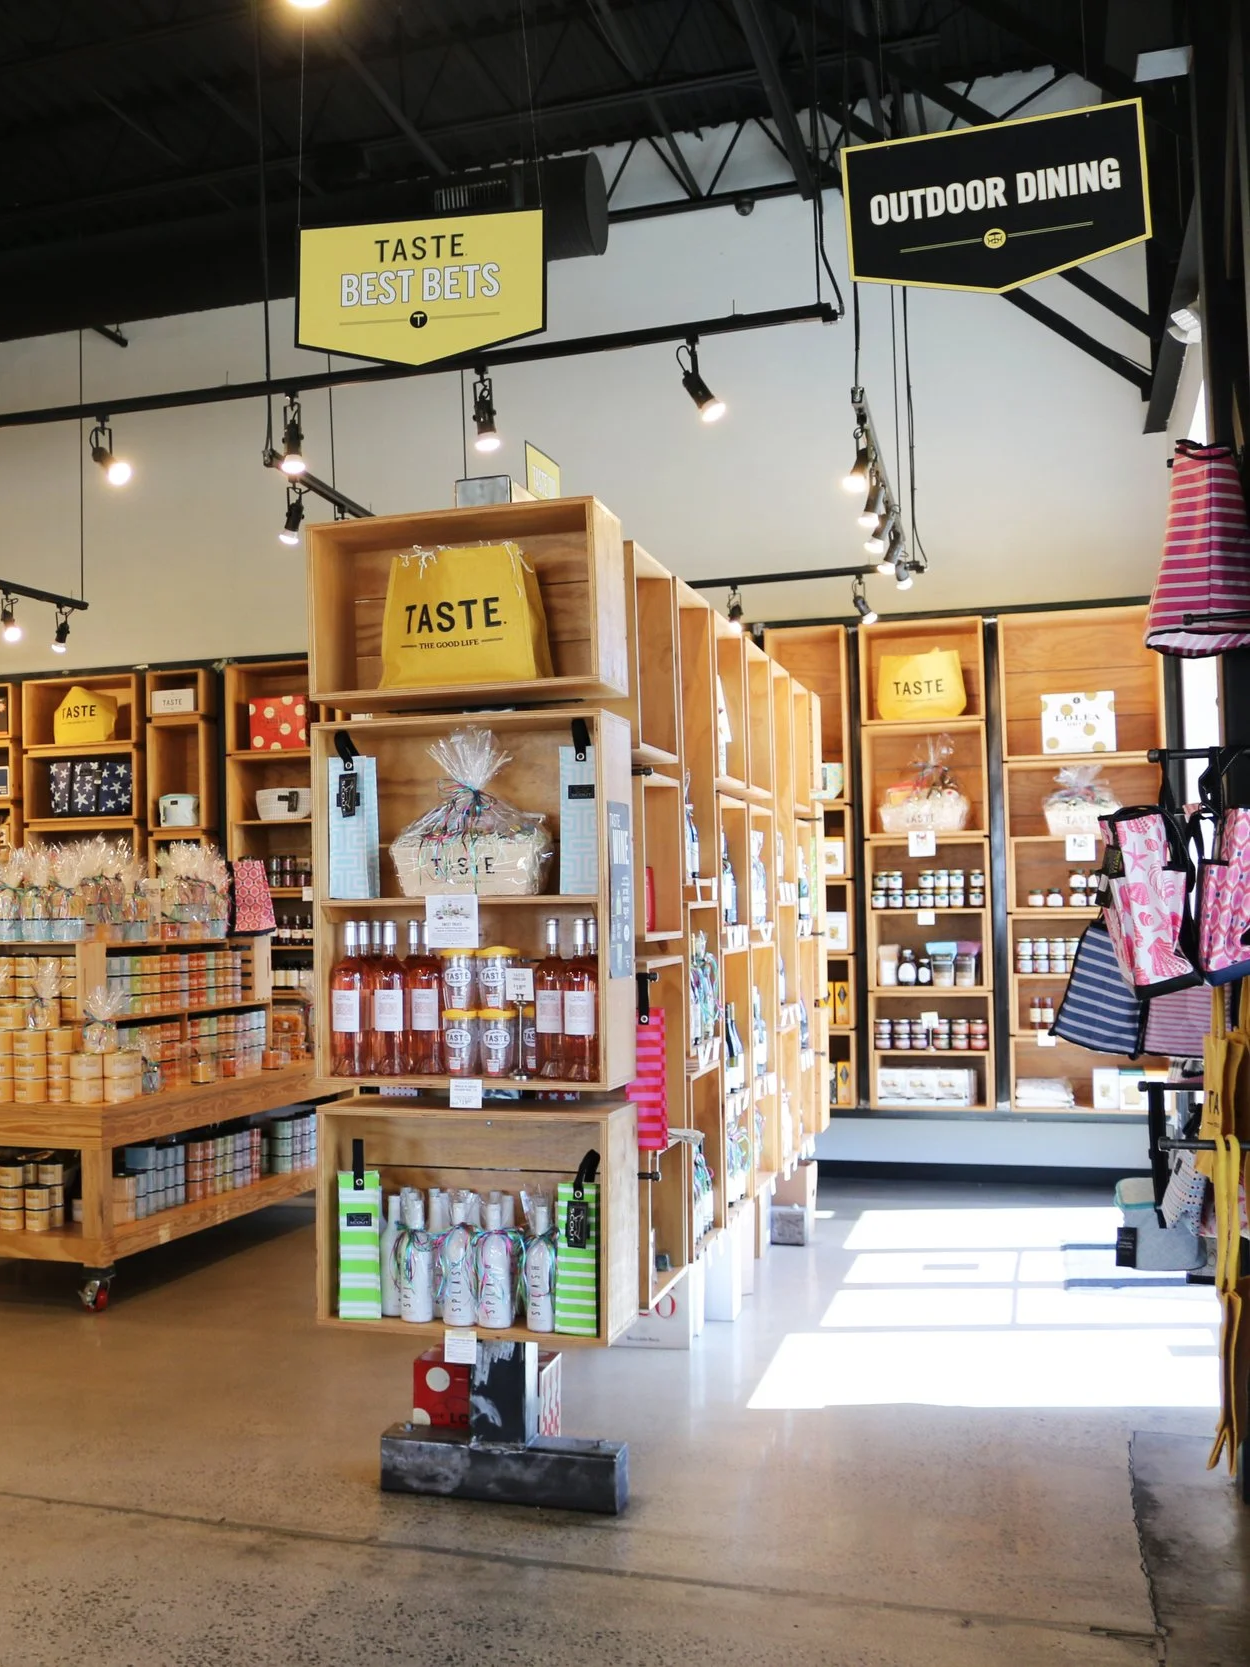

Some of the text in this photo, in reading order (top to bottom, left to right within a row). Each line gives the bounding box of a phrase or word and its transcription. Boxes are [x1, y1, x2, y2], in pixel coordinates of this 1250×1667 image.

[869, 157, 1122, 226] OUTDOOR DINING
[374, 233, 465, 263] TASTE
[340, 262, 501, 307] BEST BETS
[405, 597, 502, 634] TASTE
[419, 638, 479, 650] THE GOOD LIFE
[893, 678, 944, 695] TASTE
[162, 698, 183, 706] TASTE
[431, 857, 495, 875] TSE
[485, 1034, 508, 1042] TASTE
[524, 1032, 535, 1040] TAS
[486, 1264, 496, 1314] SPLA
